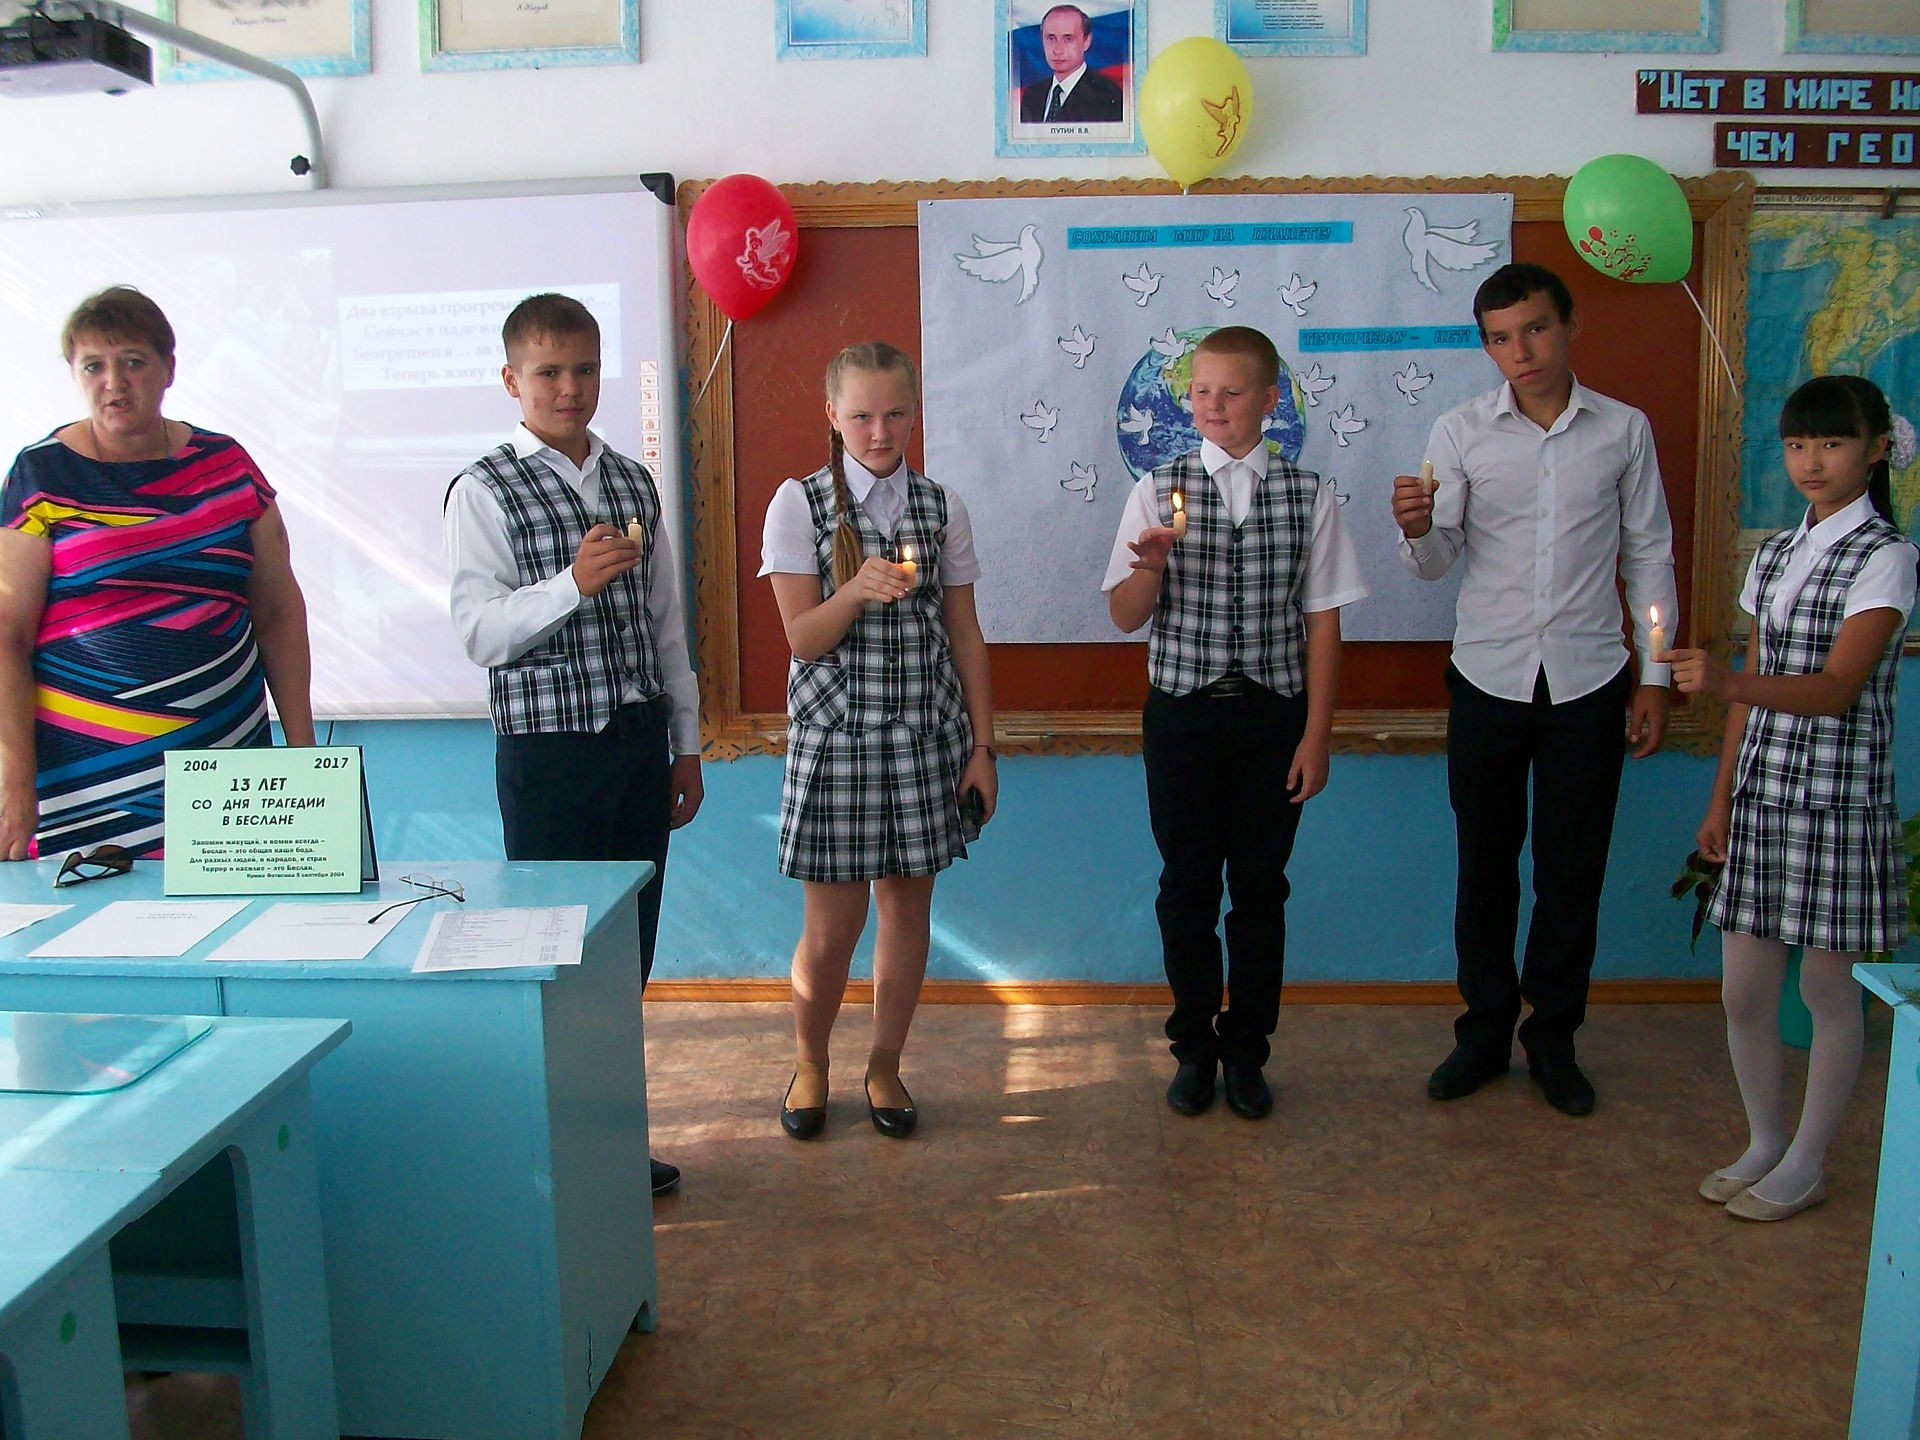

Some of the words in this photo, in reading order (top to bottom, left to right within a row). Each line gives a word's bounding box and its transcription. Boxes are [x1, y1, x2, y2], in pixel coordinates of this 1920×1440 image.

[1743, 79, 1766, 109] В
[1784, 79, 1873, 110] МИРЕ
[1727, 131, 1795, 162] ЧЕМ
[183, 760, 218, 772] 2004
[313, 757, 349, 769] 2017
[230, 779, 251, 791] 13
[258, 778, 287, 791] ЛЕТ
[192, 800, 212, 810] СО
[223, 799, 250, 810] ДНЯ
[261, 798, 326, 810] ТРАГЕДИИ
[222, 816, 230, 826] В
[236, 815, 295, 826] БЕСЛАНЕ
